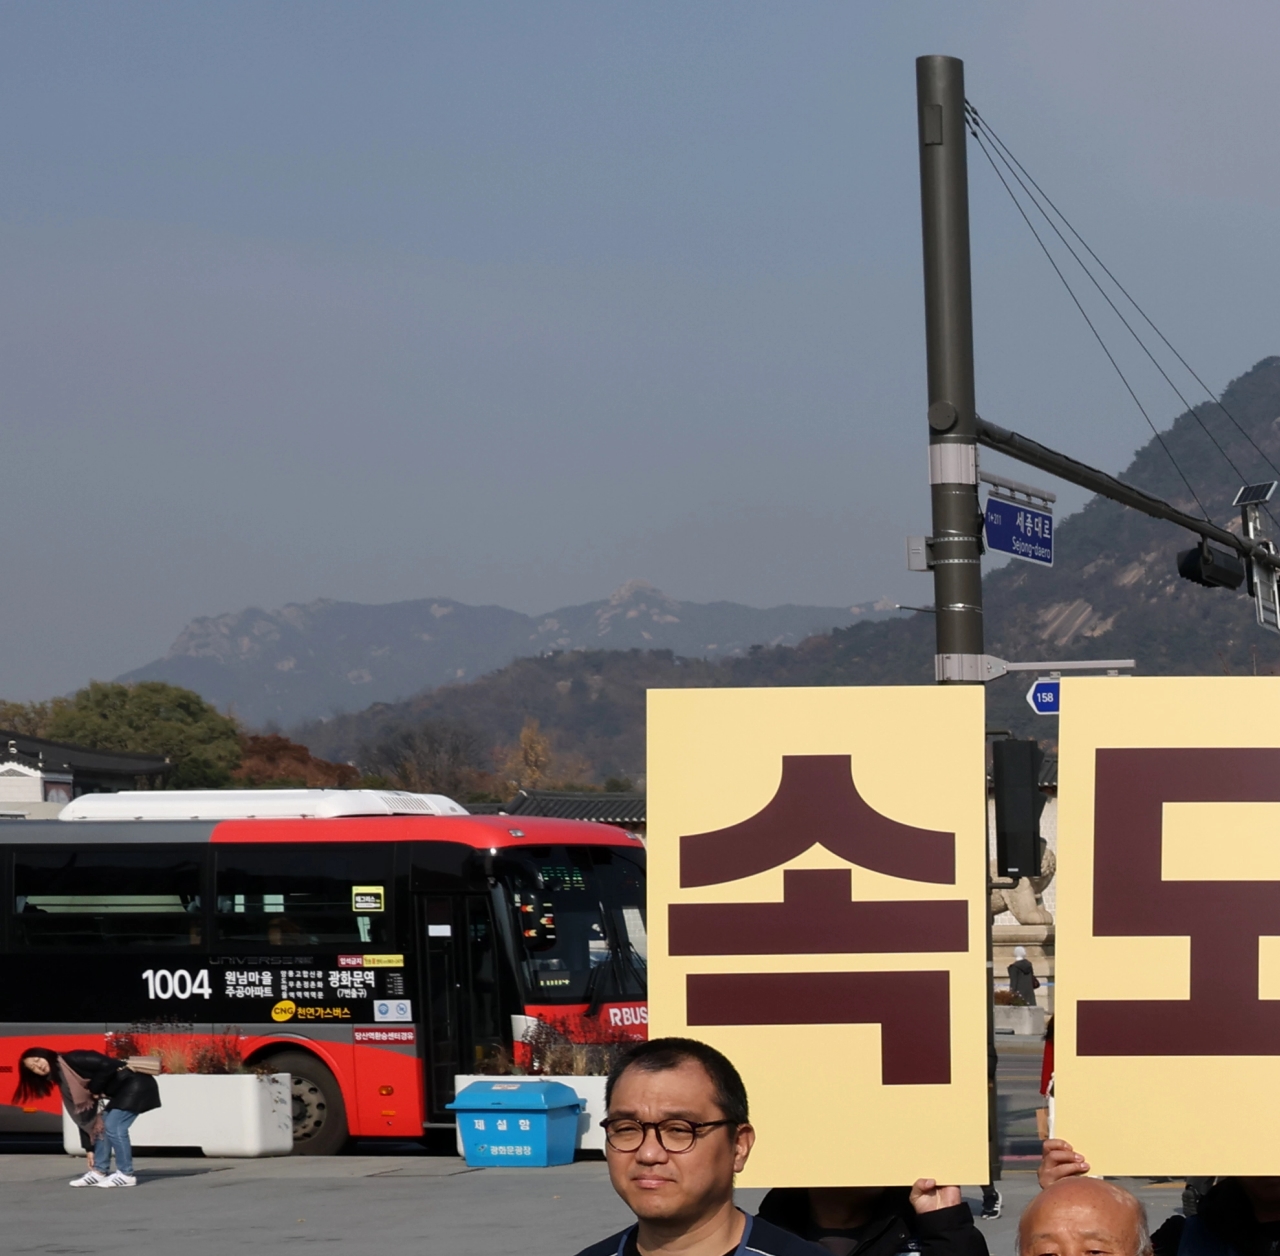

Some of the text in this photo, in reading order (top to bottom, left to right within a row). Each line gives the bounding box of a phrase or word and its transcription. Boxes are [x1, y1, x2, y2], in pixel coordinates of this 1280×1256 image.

[1015, 511, 1051, 539] 세종대로
[1012, 536, 1051, 559] Sejong-daero
[1037, 692, 1054, 703] 158
[668, 755, 969, 1085] 속
[142, 969, 212, 999] 1004
[328, 970, 375, 988] 광화문역
[225, 986, 274, 998] 주공아파트
[337, 988, 367, 998] (7번출구)
[273, 1006, 294, 1014] CNG
[297, 1007, 351, 1019] 천연가스버스
[490, 1146, 531, 1155] 광화문광장
